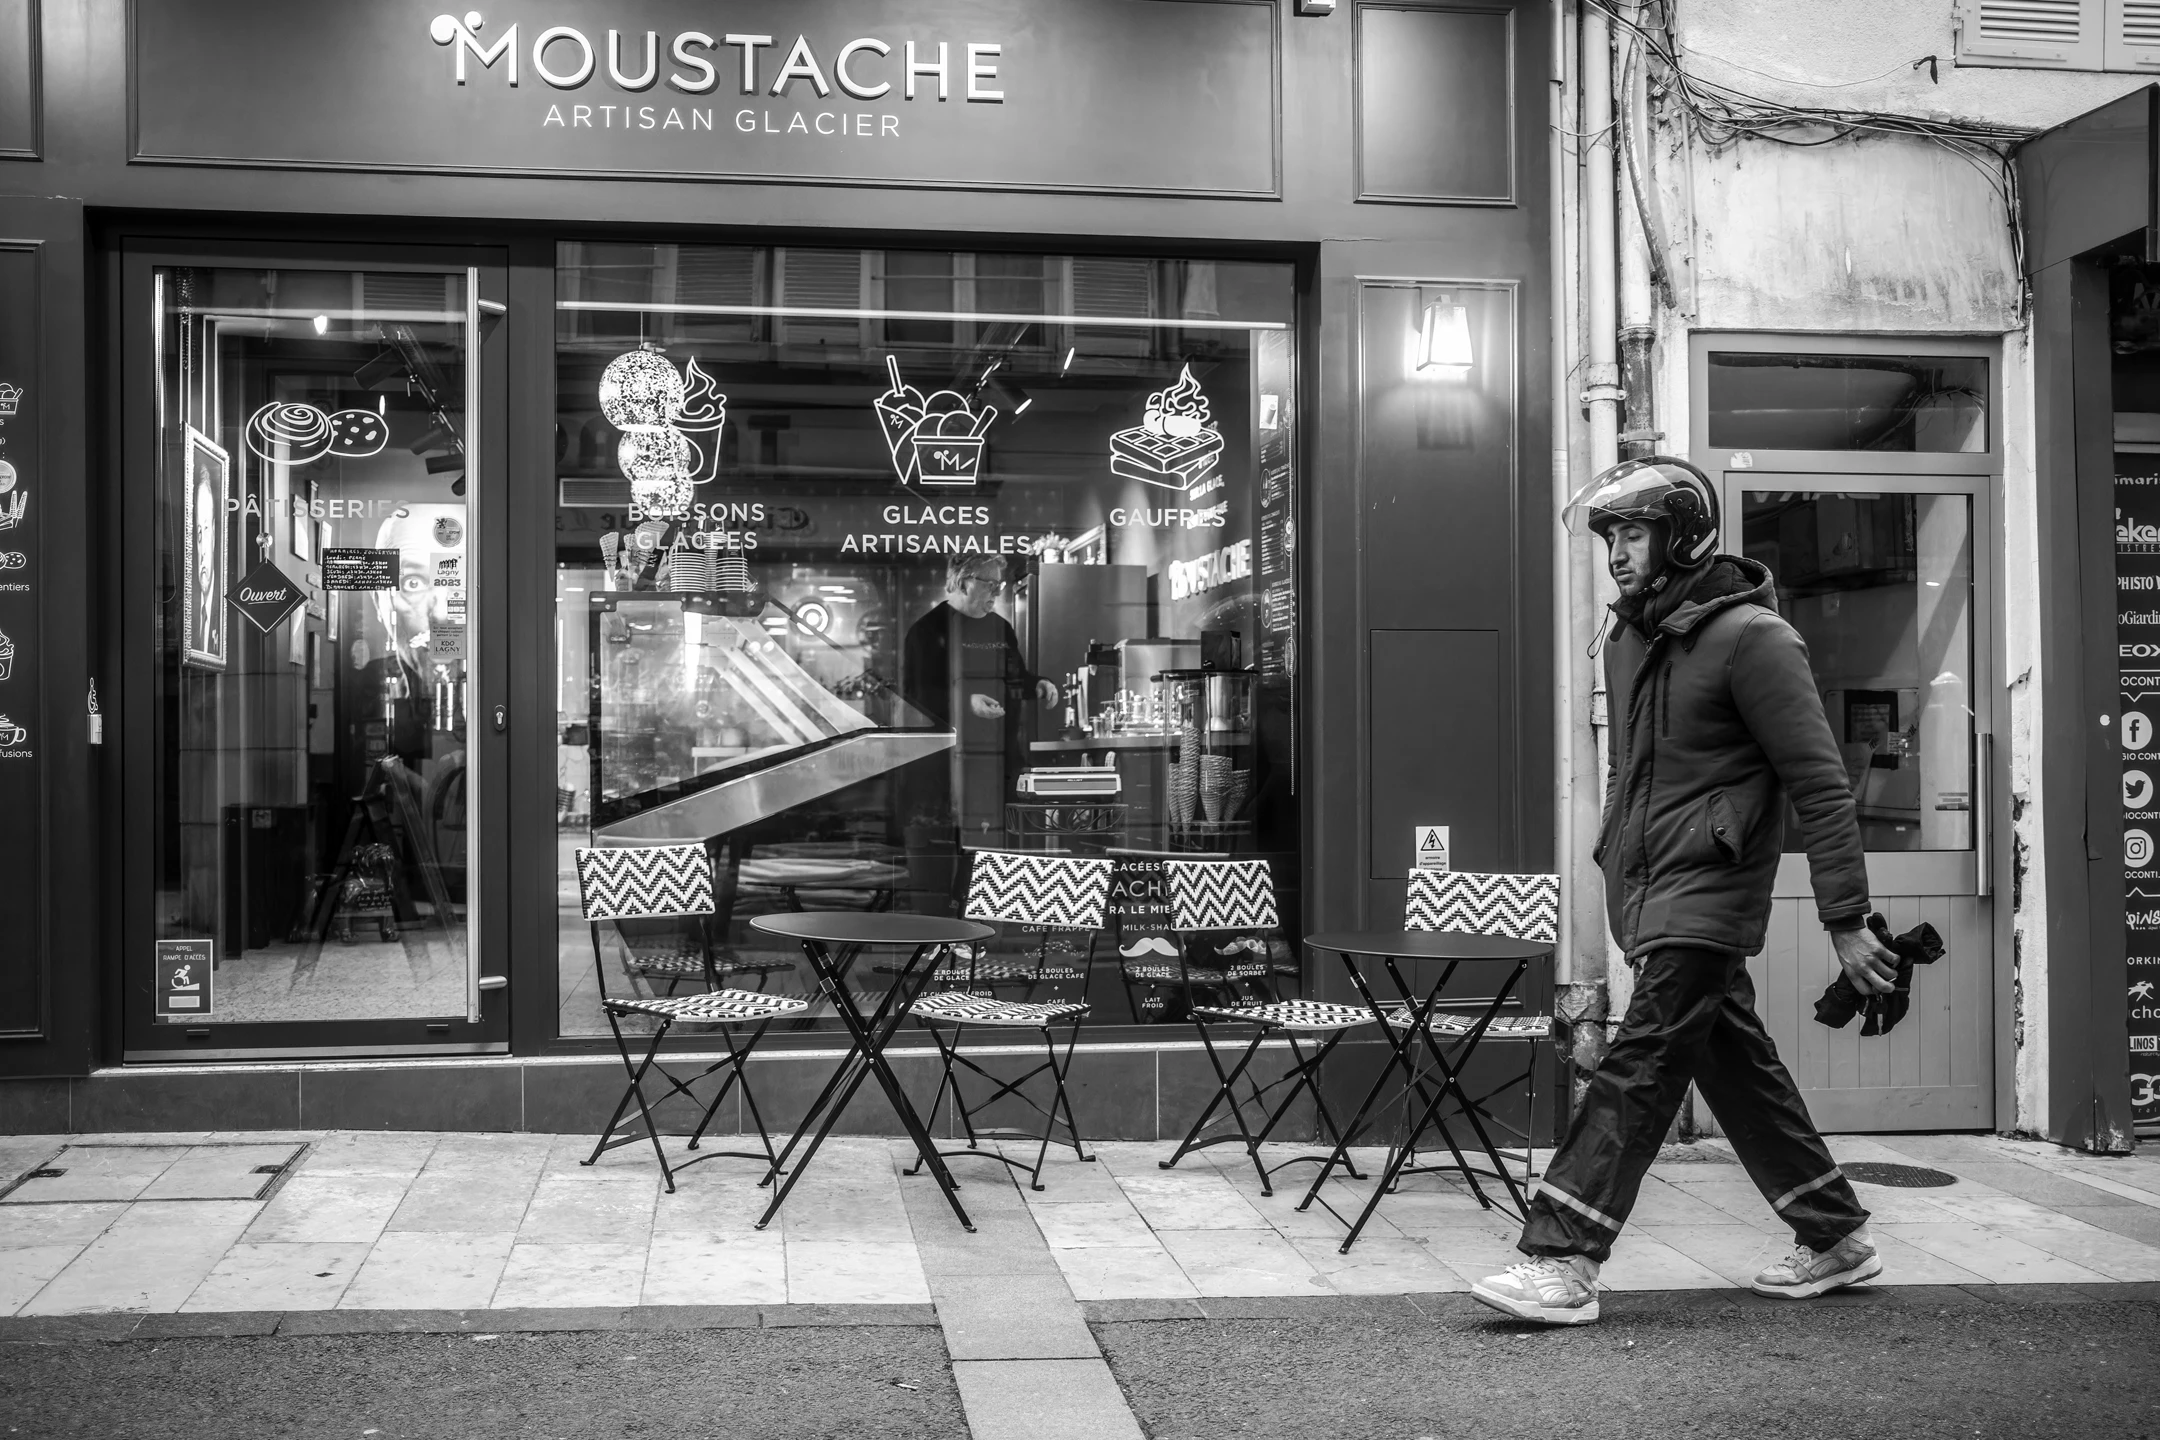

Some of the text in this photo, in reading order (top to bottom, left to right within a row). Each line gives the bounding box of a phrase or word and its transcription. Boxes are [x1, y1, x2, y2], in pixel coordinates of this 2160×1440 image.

[430, 11, 1004, 101] MOUSTACHE
[543, 104, 900, 137] ARTISAN GLACIER
[225, 494, 410, 518] PÂTISSERIES
[882, 505, 989, 525] GLACES
[1110, 508, 1226, 527] GAUFRES
[840, 534, 1032, 554] ARTISANALES
[433, 578, 461, 587] 2023
[240, 586, 288, 602] Ouvert
[1111, 880, 1161, 897] ACH
[1131, 905, 1145, 914] LE
